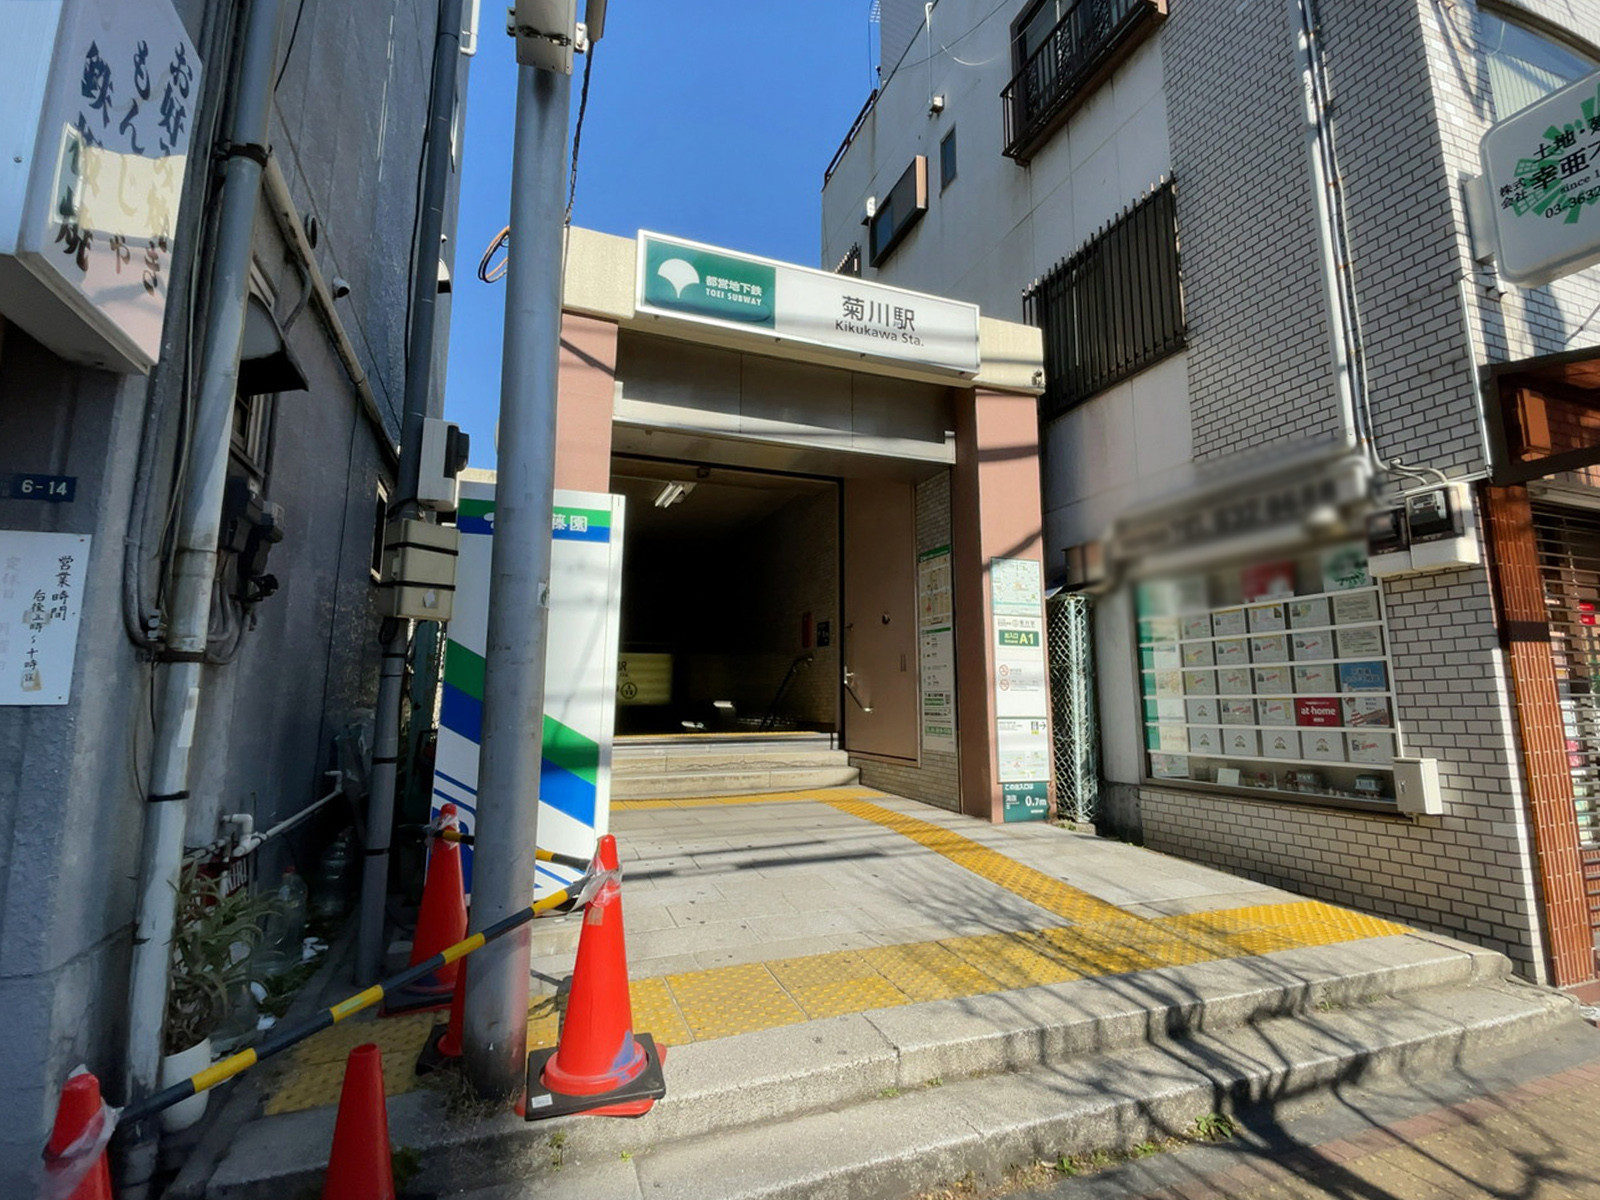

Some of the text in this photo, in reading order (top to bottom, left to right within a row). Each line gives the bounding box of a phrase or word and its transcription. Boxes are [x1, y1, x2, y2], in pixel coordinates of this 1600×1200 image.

[1500, 177, 1527, 198] 株式
[1502, 189, 1529, 210] 会社
[706, 275, 763, 297] 都営地下鉄
[706, 287, 762, 307] TOEI SUBWAY
[842, 295, 916, 333] 菊川駅
[835, 319, 925, 347] Kikukawa Sta.
[21, 479, 68, 496] 6-14
[50, 554, 74, 622] 営業時間
[1019, 632, 1034, 645] A1
